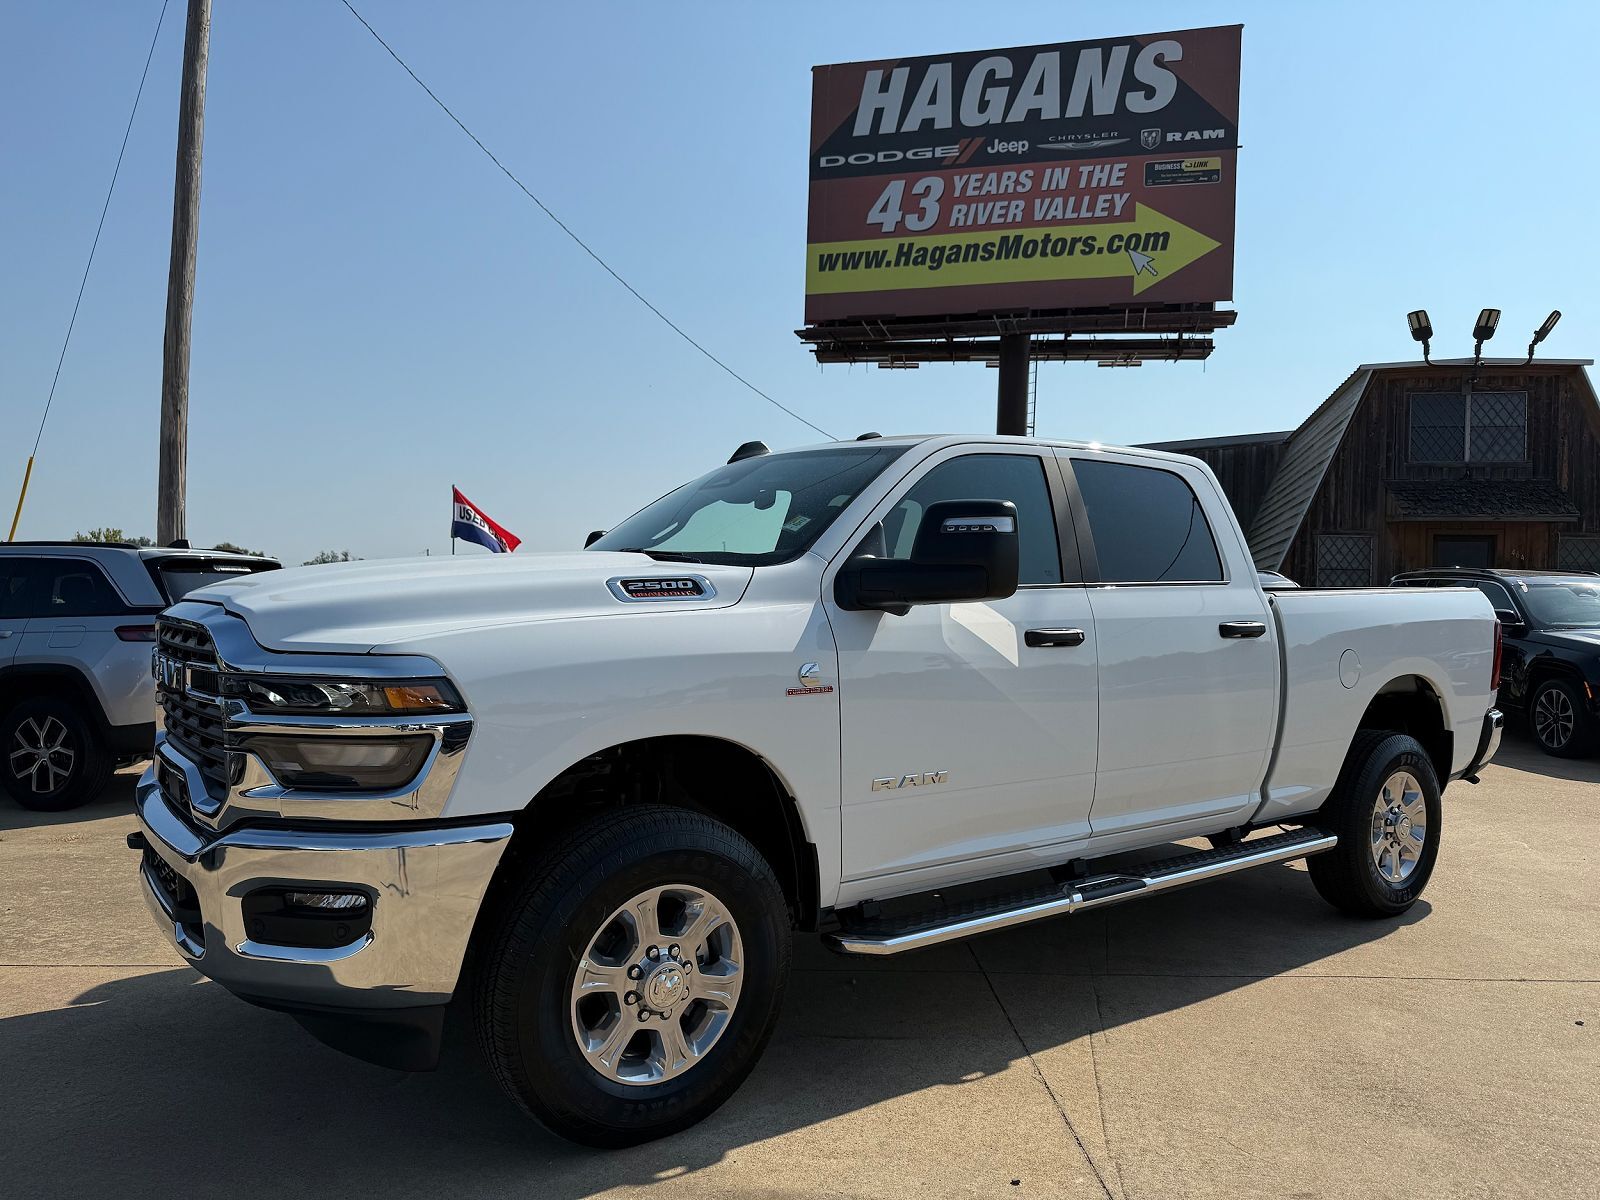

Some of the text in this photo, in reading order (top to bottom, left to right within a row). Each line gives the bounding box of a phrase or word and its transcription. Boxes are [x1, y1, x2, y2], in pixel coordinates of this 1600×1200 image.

[852, 40, 1184, 137] HAGANS
[987, 138, 1029, 155] Jeep
[1048, 131, 1119, 142] CHRYSLER
[1166, 129, 1225, 142] RAM
[819, 145, 960, 168] DODGE
[1154, 162, 1181, 171] BUSINESS
[952, 163, 1128, 198] YEARS IN THE
[866, 176, 945, 233] 43
[949, 192, 1131, 228] RIVER VALLEY
[818, 230, 1170, 272] www.HagansMotors.com
[459, 505, 486, 528] USED
[628, 580, 693, 590] 2500
[872, 770, 949, 792] RAM
